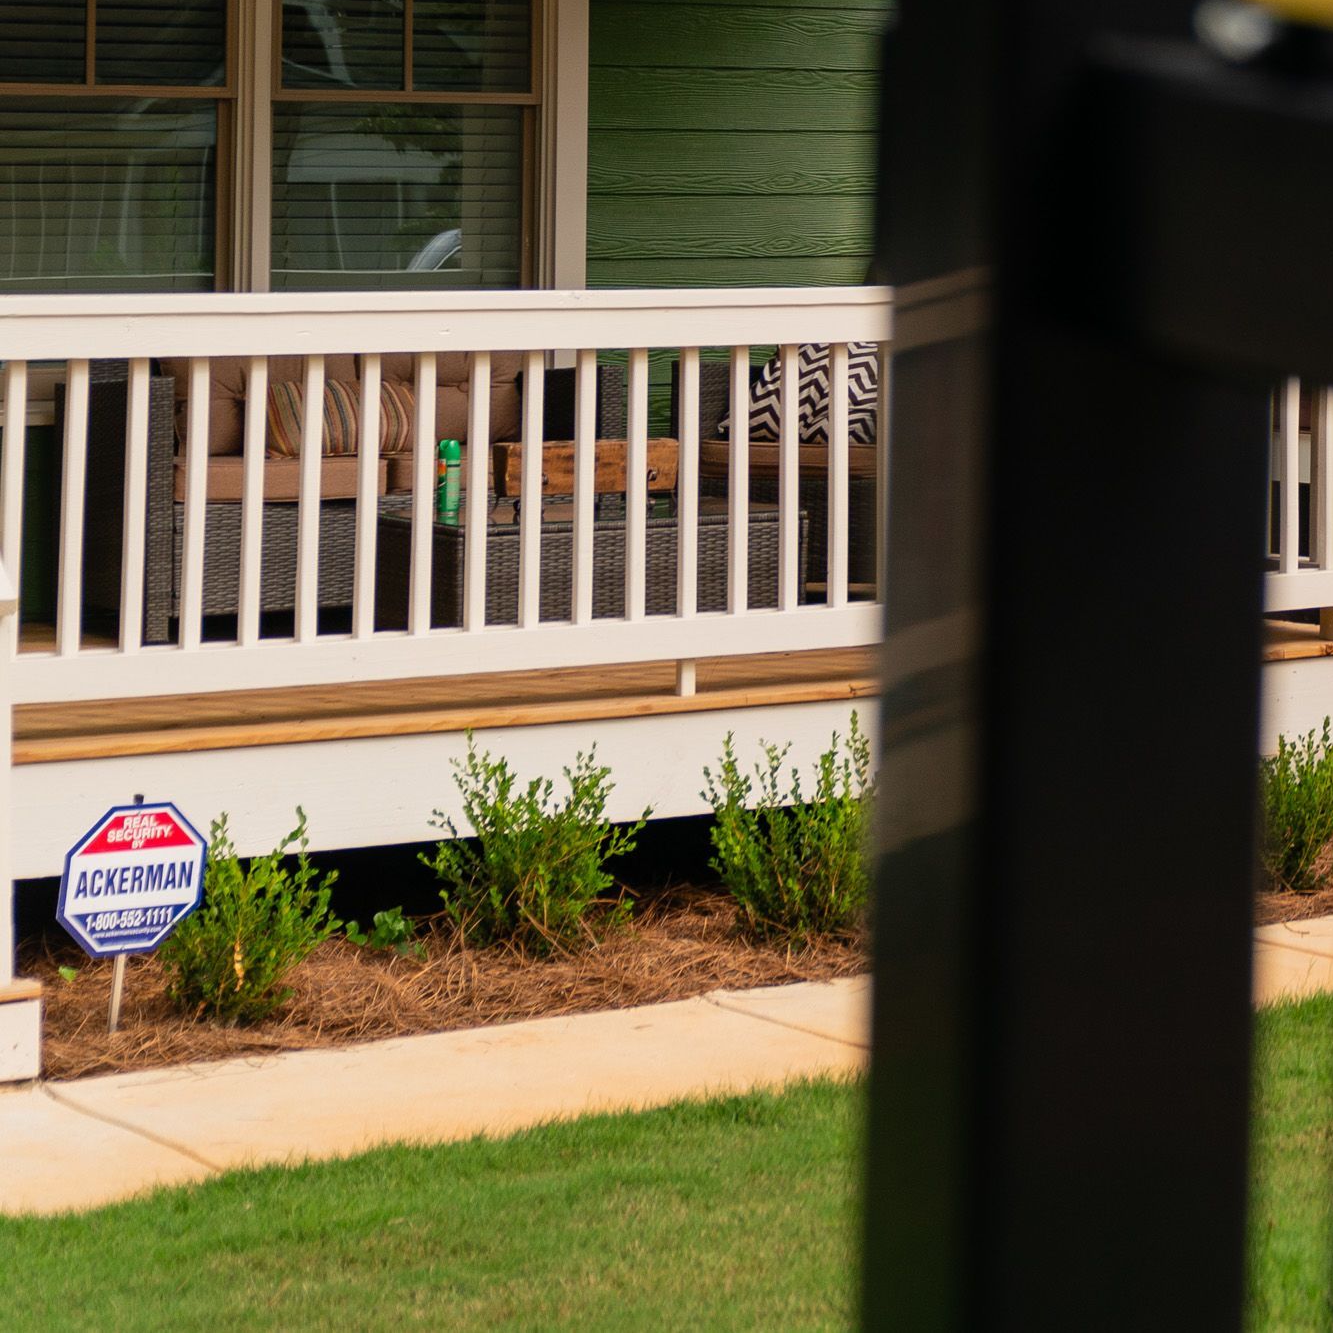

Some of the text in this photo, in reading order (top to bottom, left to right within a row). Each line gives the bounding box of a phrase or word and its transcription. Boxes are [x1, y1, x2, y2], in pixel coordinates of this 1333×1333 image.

[123, 815, 158, 829] REAL
[106, 824, 173, 843] SECURITY
[131, 840, 145, 849] BY
[74, 861, 194, 899] ACKERMAN
[86, 906, 173, 932] 1-800-552-1111
